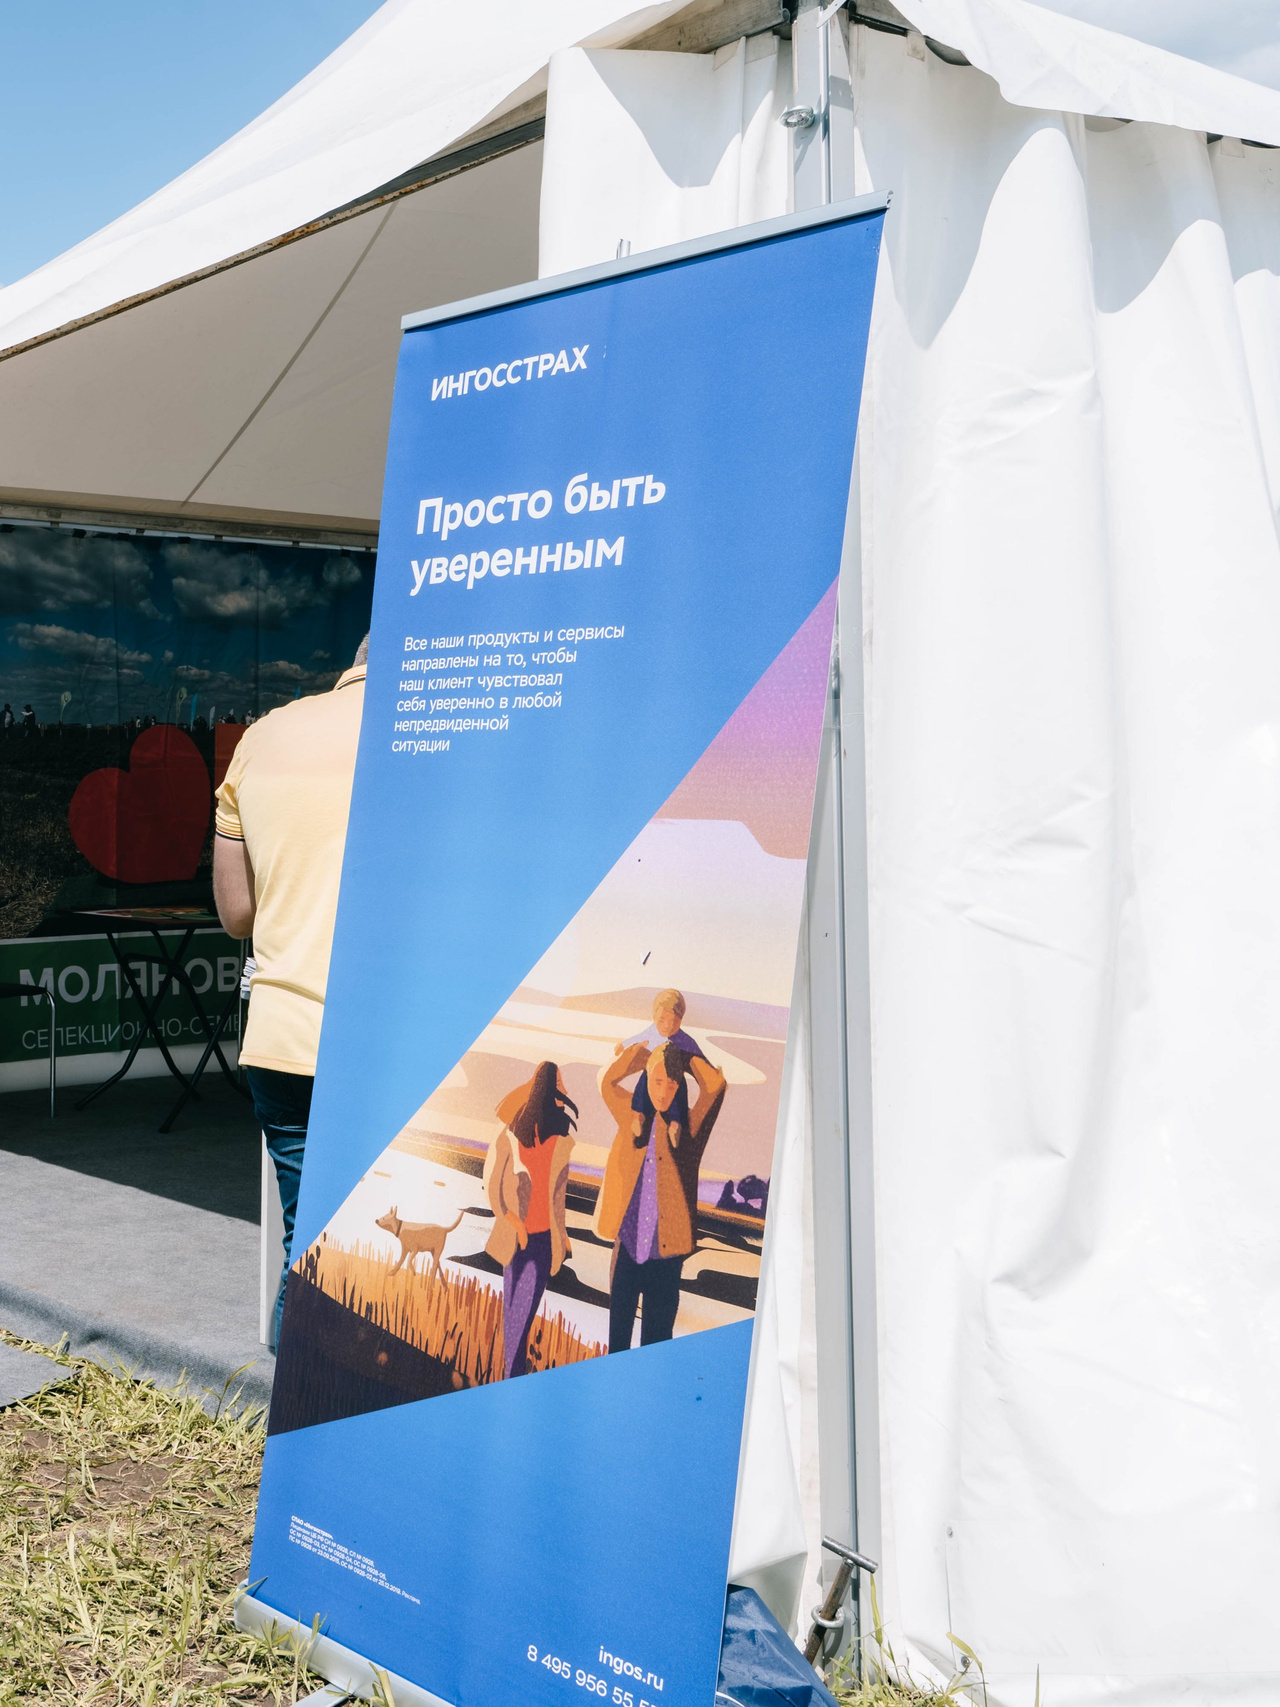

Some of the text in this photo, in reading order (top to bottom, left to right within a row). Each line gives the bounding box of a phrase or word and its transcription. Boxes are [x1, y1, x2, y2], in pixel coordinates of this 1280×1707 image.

[431, 344, 590, 402] ИНГОССТРАХ
[416, 472, 666, 541] Просто быть
[410, 535, 625, 597] уверенным
[404, 625, 625, 651] Все наши продукты и сервисы
[401, 646, 578, 674] направлены на то, чтобы
[398, 672, 563, 692] наш клиент чувствовал
[396, 691, 562, 714] себя уверенно в любой
[394, 715, 510, 735] непредвиденной
[391, 739, 451, 756] ситуации
[19, 956, 240, 1007] МОЛЯНОВ
[527, 1644, 634, 1707] 8 495 956 55
[598, 1645, 664, 1692] ingos.ru
